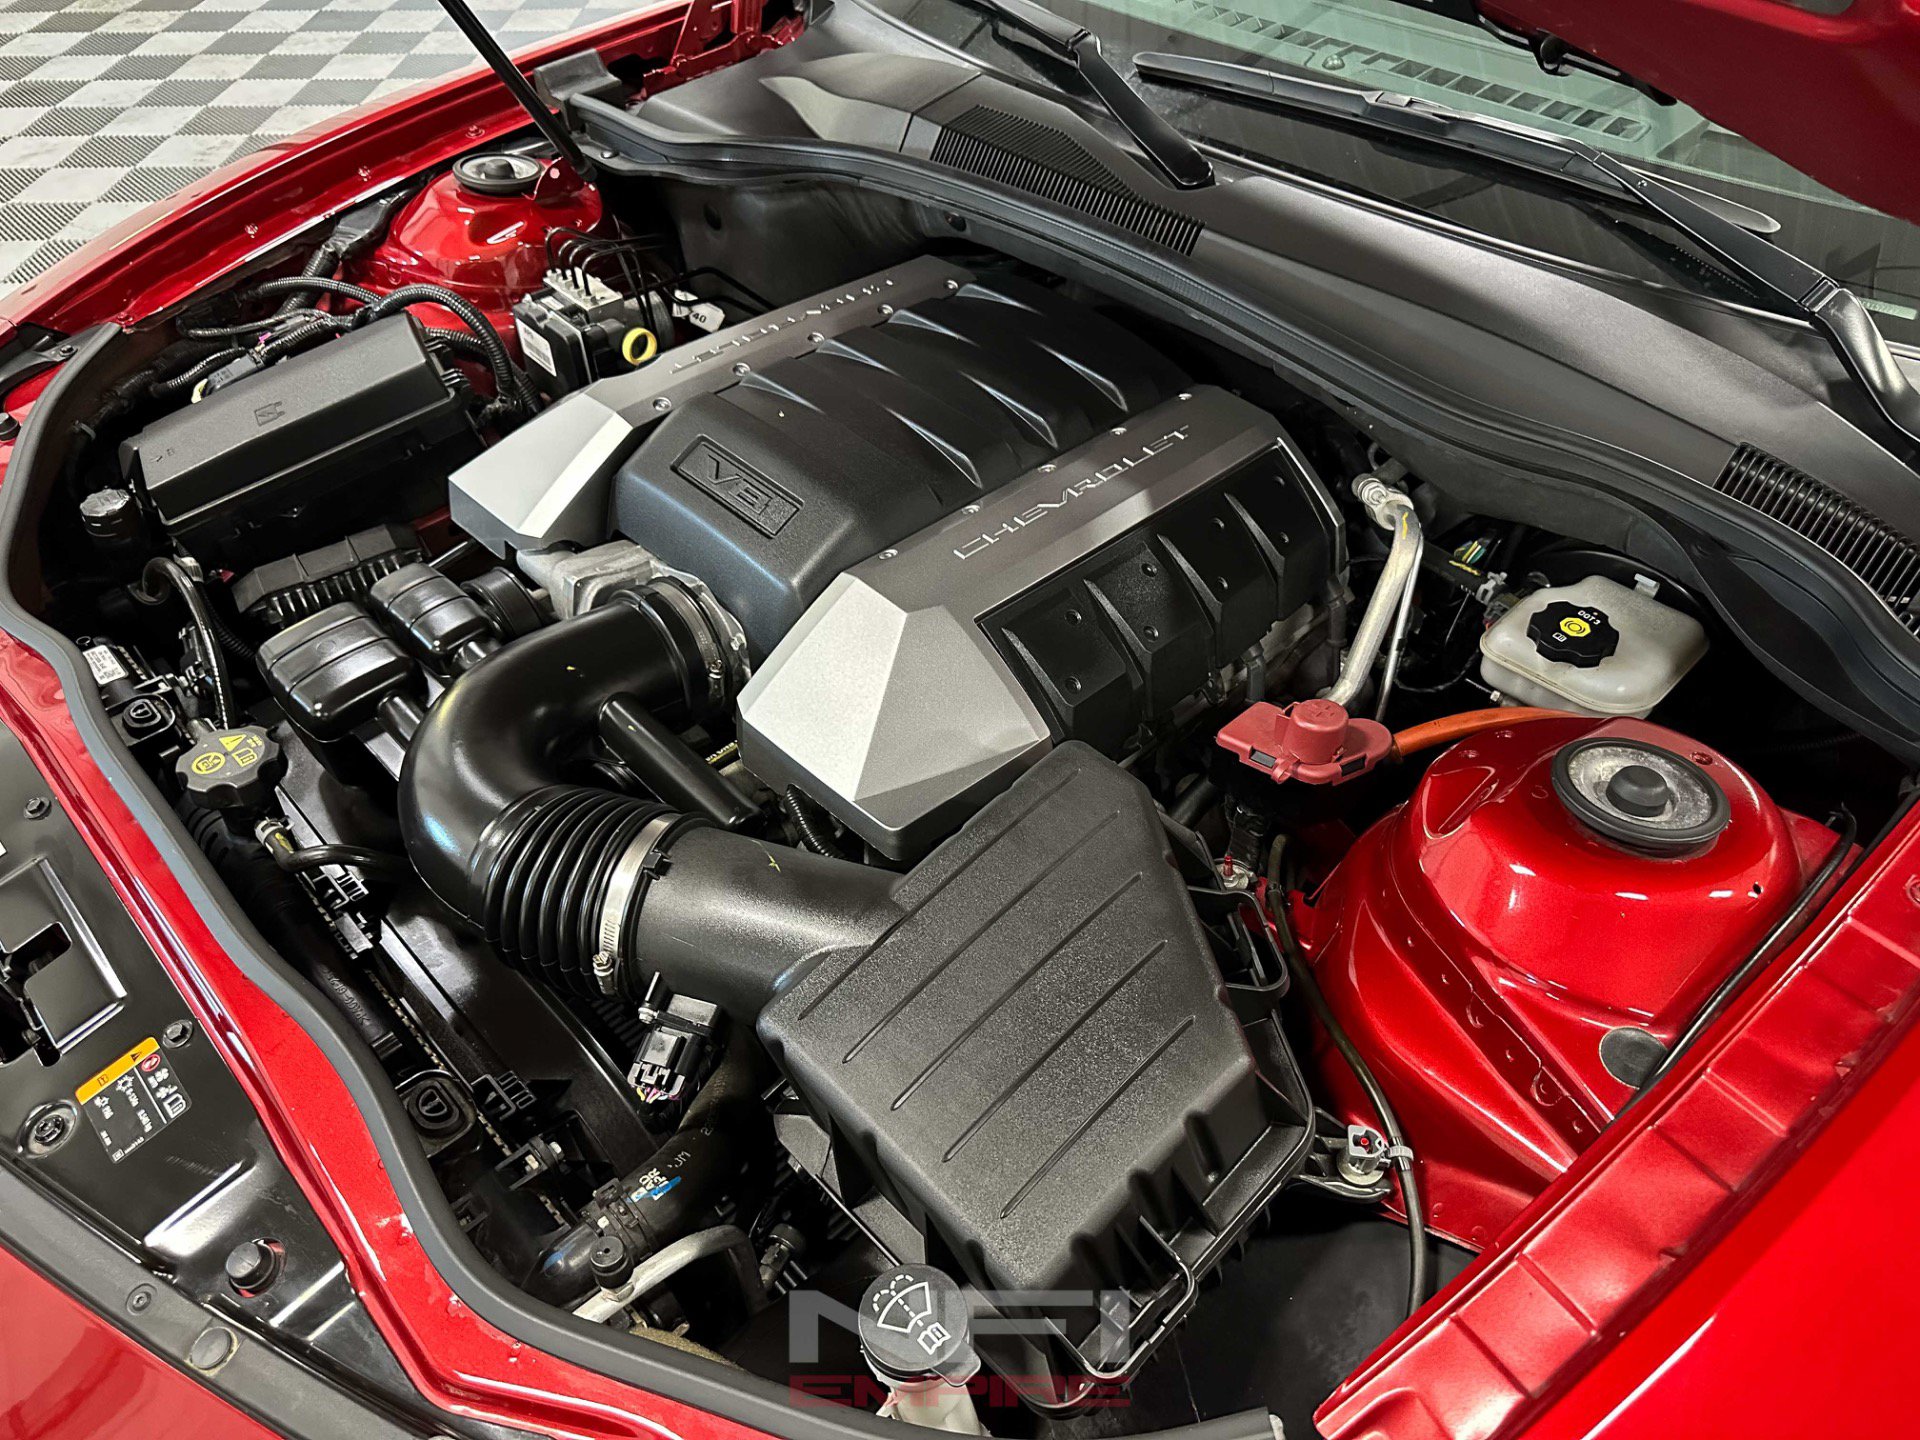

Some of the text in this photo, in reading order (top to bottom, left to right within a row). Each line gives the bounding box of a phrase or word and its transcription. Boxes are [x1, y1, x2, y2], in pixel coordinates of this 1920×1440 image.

[692, 312, 707, 323] 40
[706, 453, 774, 516] V8
[953, 424, 1188, 560] CHEVROLET
[1577, 610, 1596, 622] DOT
